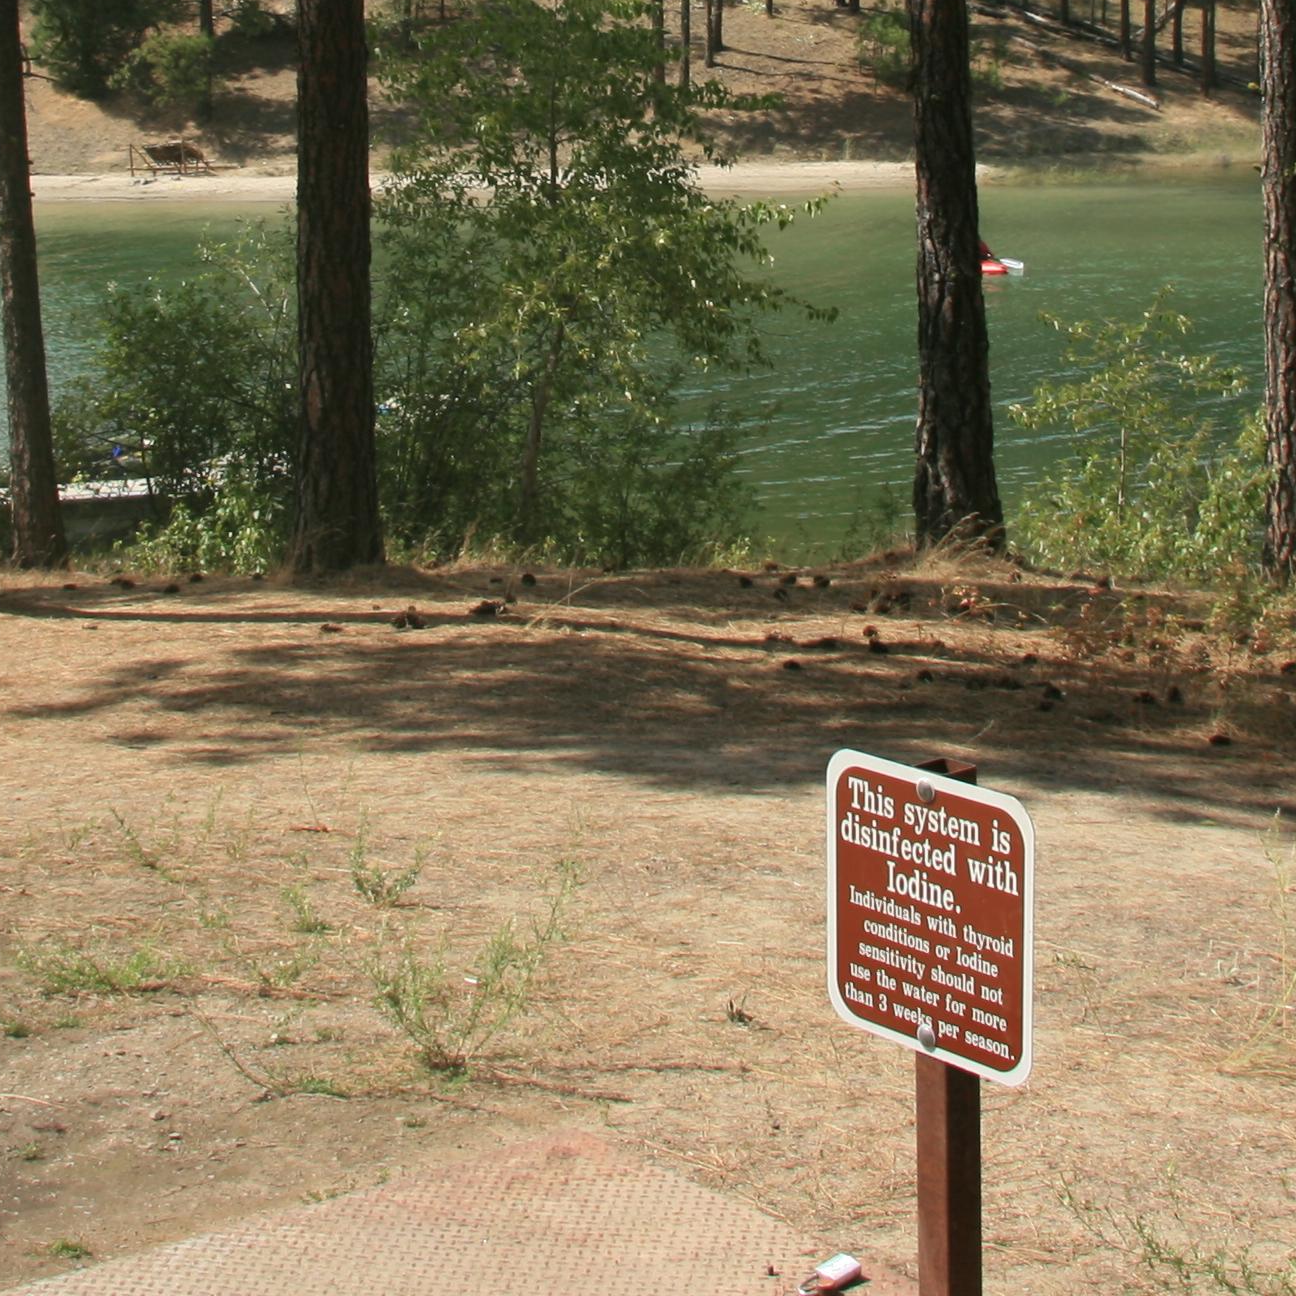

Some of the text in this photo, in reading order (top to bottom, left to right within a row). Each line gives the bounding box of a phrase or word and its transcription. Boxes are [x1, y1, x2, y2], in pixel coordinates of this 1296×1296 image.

[848, 776, 1010, 855] This system is
[841, 812, 1018, 896] disinfected with
[886, 861, 961, 913] Iodine.
[850, 886, 1014, 958] Individuals with thyroid
[864, 918, 998, 977] conditions or Iodine
[850, 963, 1007, 1032] use the water for more
[859, 942, 1003, 1005] sensitivity should not
[845, 982, 1015, 1061] than 3 weeks per season.
